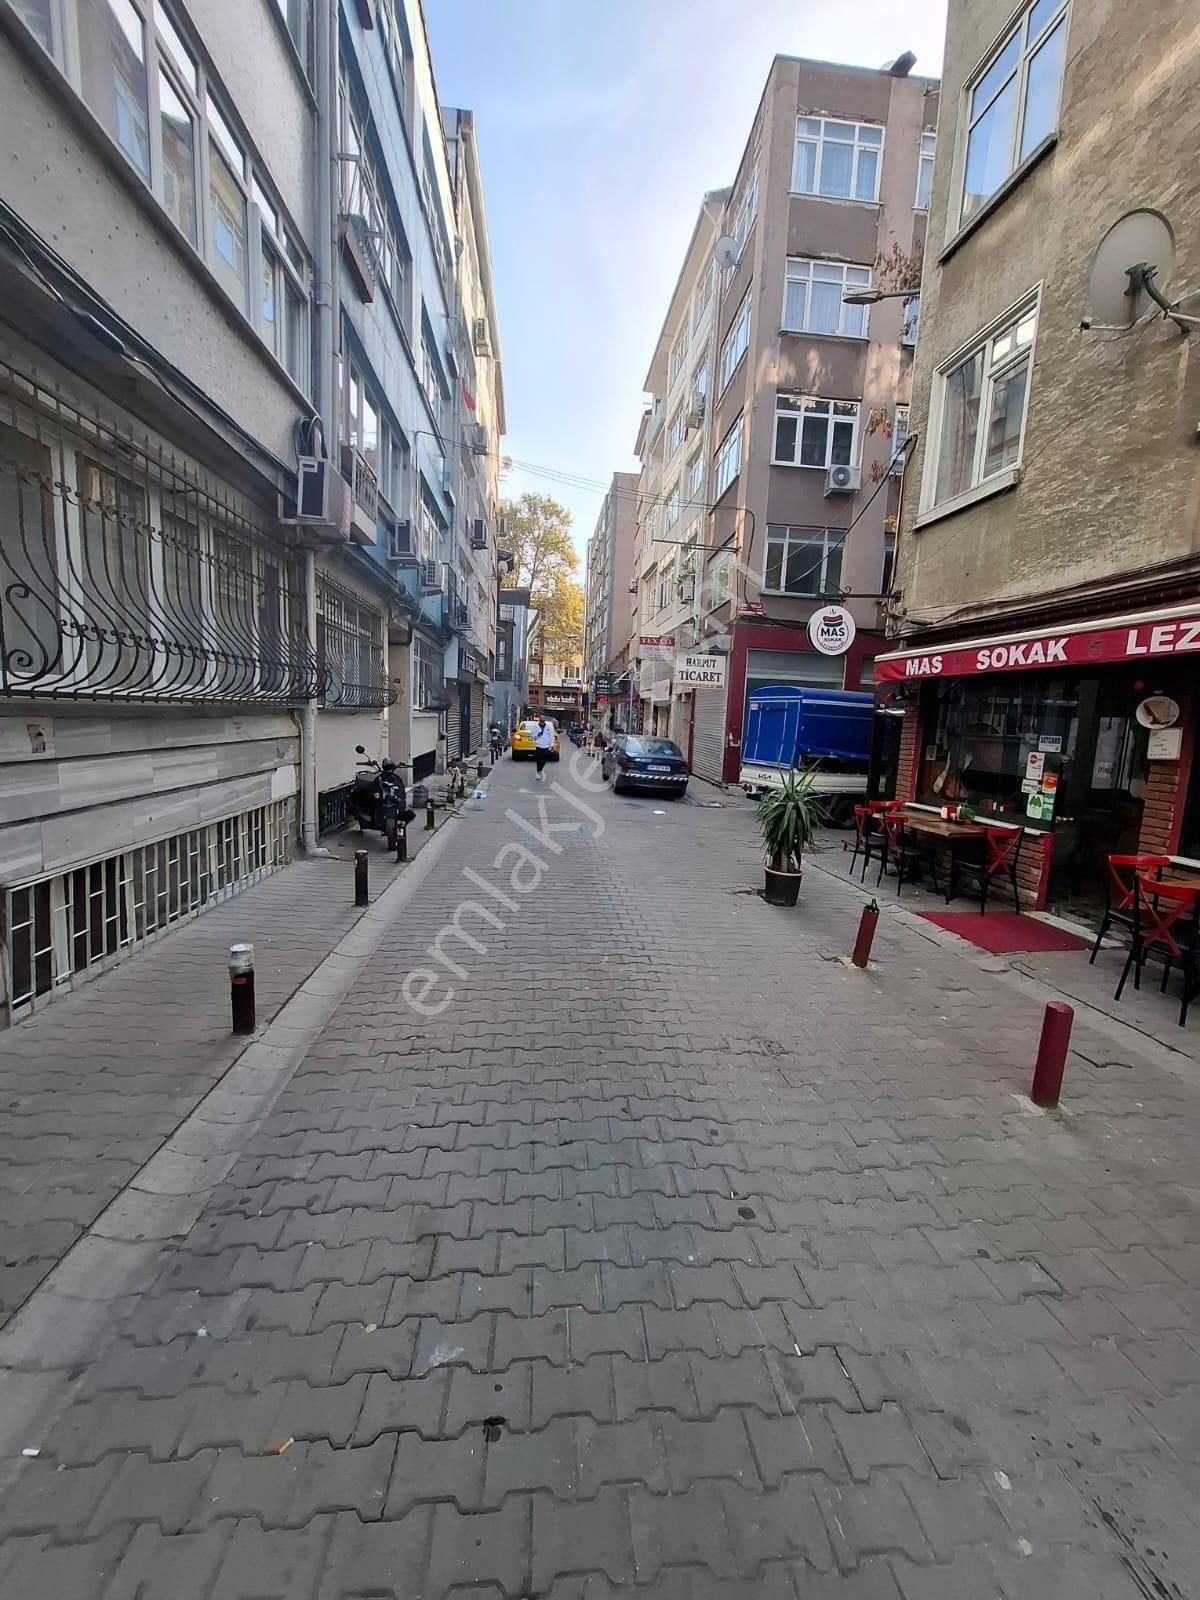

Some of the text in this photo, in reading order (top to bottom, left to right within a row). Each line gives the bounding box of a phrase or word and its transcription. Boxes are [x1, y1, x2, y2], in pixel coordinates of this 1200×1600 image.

[820, 627, 845, 637] MAS
[686, 657, 717, 668] HARPUT
[905, 656, 943, 677] MAS
[976, 637, 1072, 670] SOKAK
[679, 668, 722, 682] TİCARET
